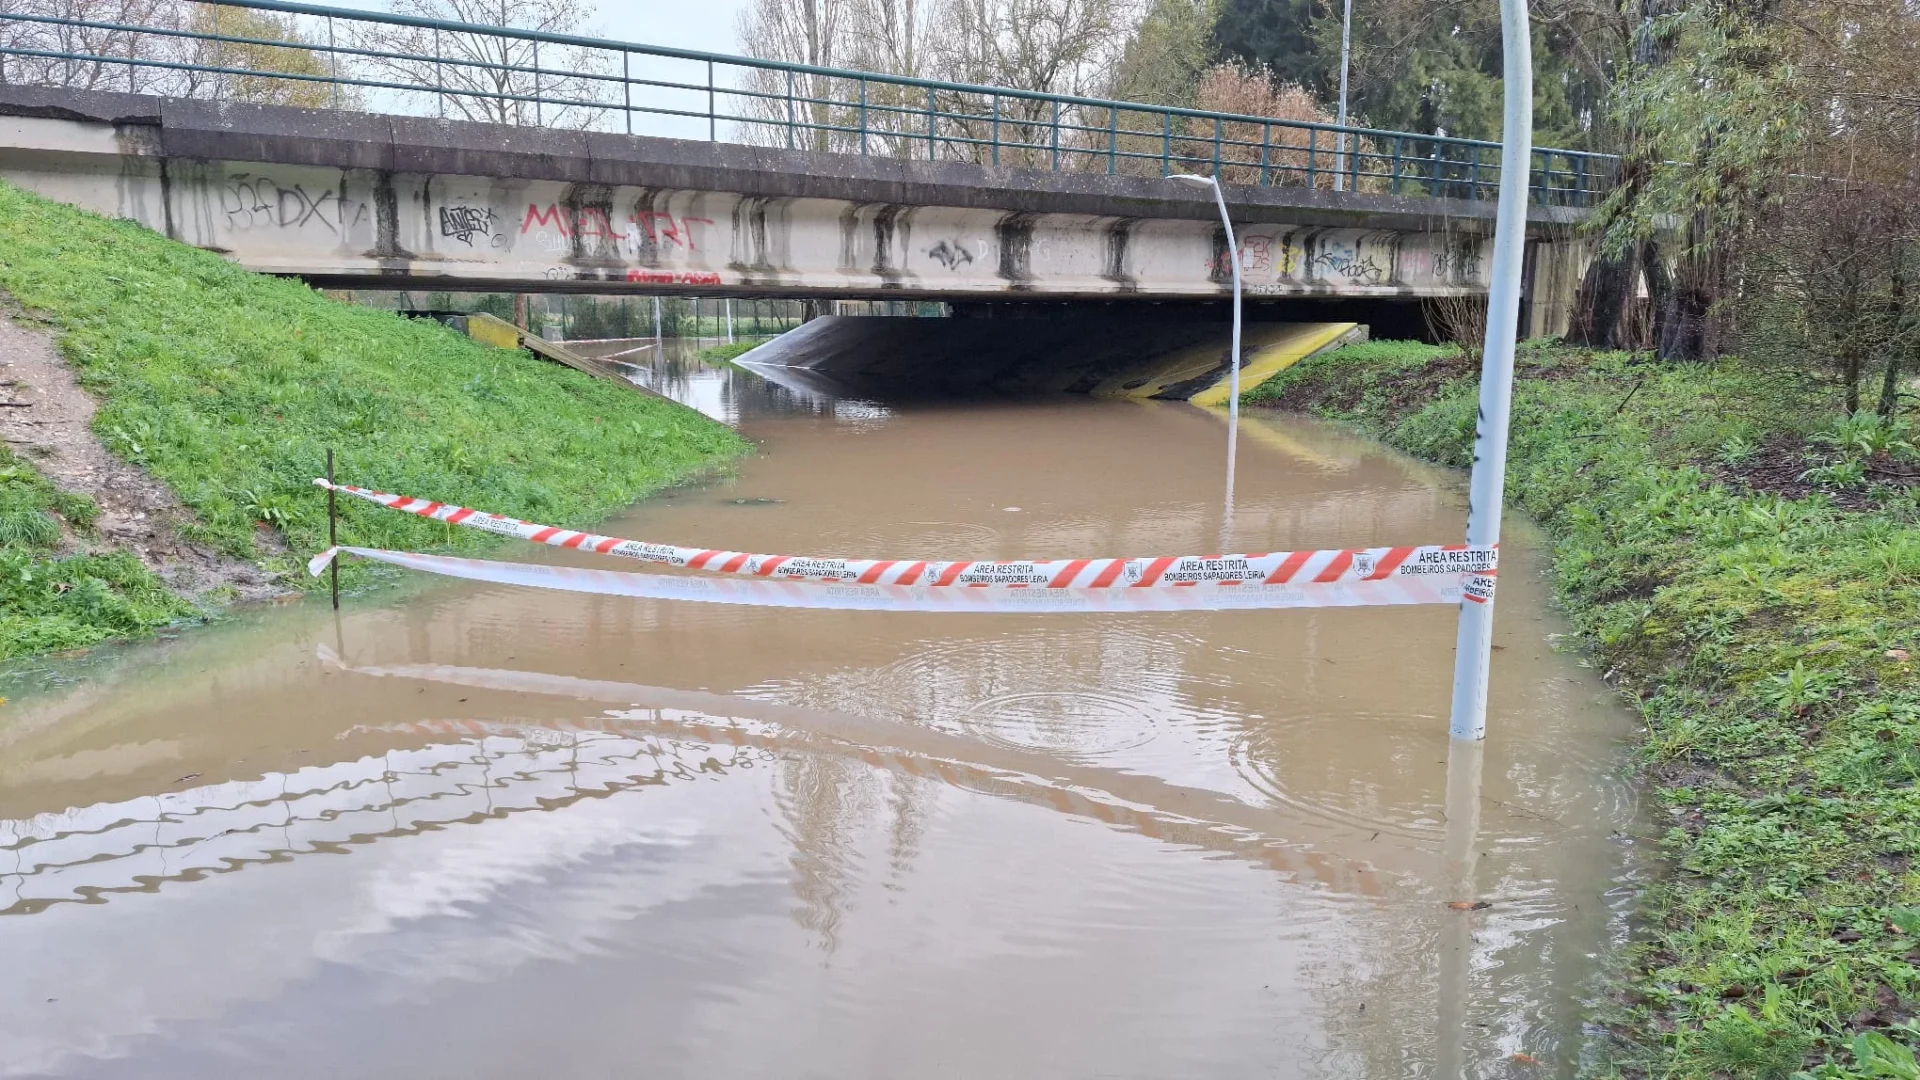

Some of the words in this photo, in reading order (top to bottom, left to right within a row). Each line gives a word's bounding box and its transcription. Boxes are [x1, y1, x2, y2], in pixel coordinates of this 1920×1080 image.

[1418, 550, 1447, 563] ÁREA
[1448, 550, 1497, 563] RESTRITA
[996, 564, 1034, 574] RESTRITA
[1180, 559, 1204, 572] ÁREA
[1205, 559, 1249, 571] RESTRITA
[1400, 565, 1445, 575] BOMBEIROS
[1446, 562, 1491, 574] SAPADORES
[1164, 571, 1203, 581] BOMBEIROS
[1203, 570, 1243, 581] SAPADORES
[1243, 570, 1266, 580] LEIRIA
